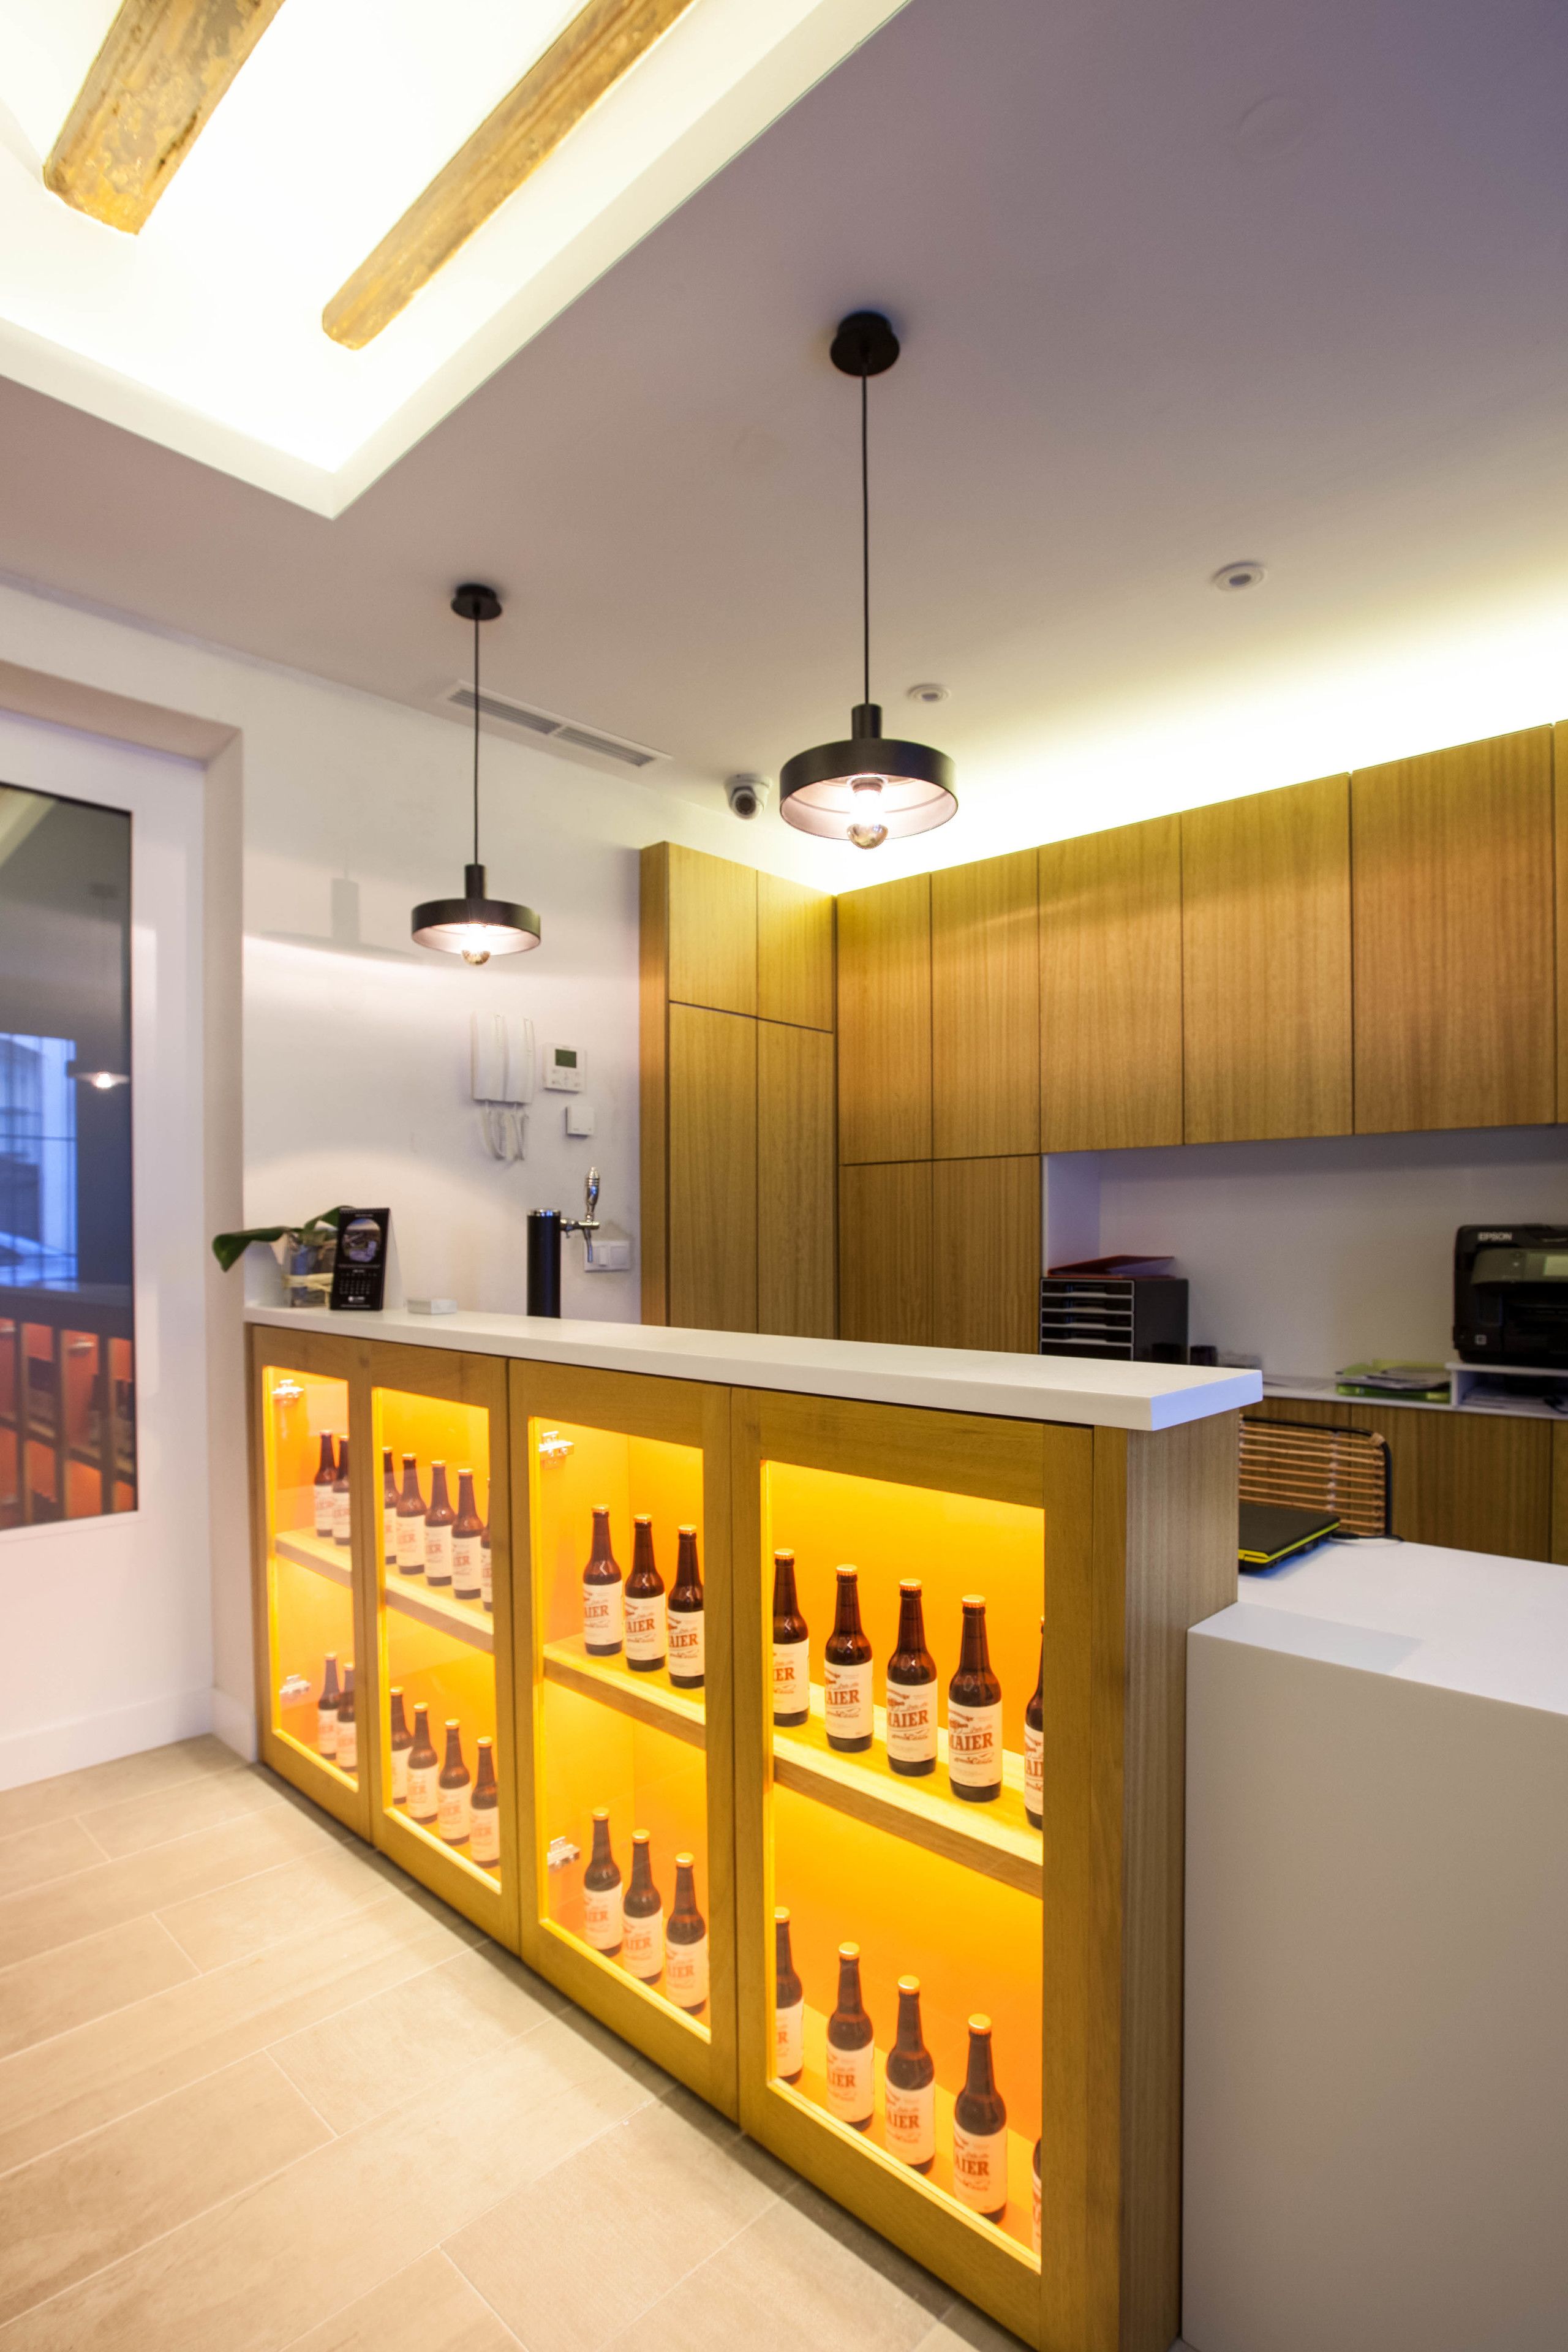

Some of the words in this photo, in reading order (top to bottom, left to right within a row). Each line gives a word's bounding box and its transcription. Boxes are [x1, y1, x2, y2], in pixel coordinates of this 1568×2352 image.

[1478, 1232, 1513, 1241] EPSON
[627, 1618, 655, 1633] AIER
[669, 1634, 698, 1648] AIER
[827, 1689, 860, 1705] AIER
